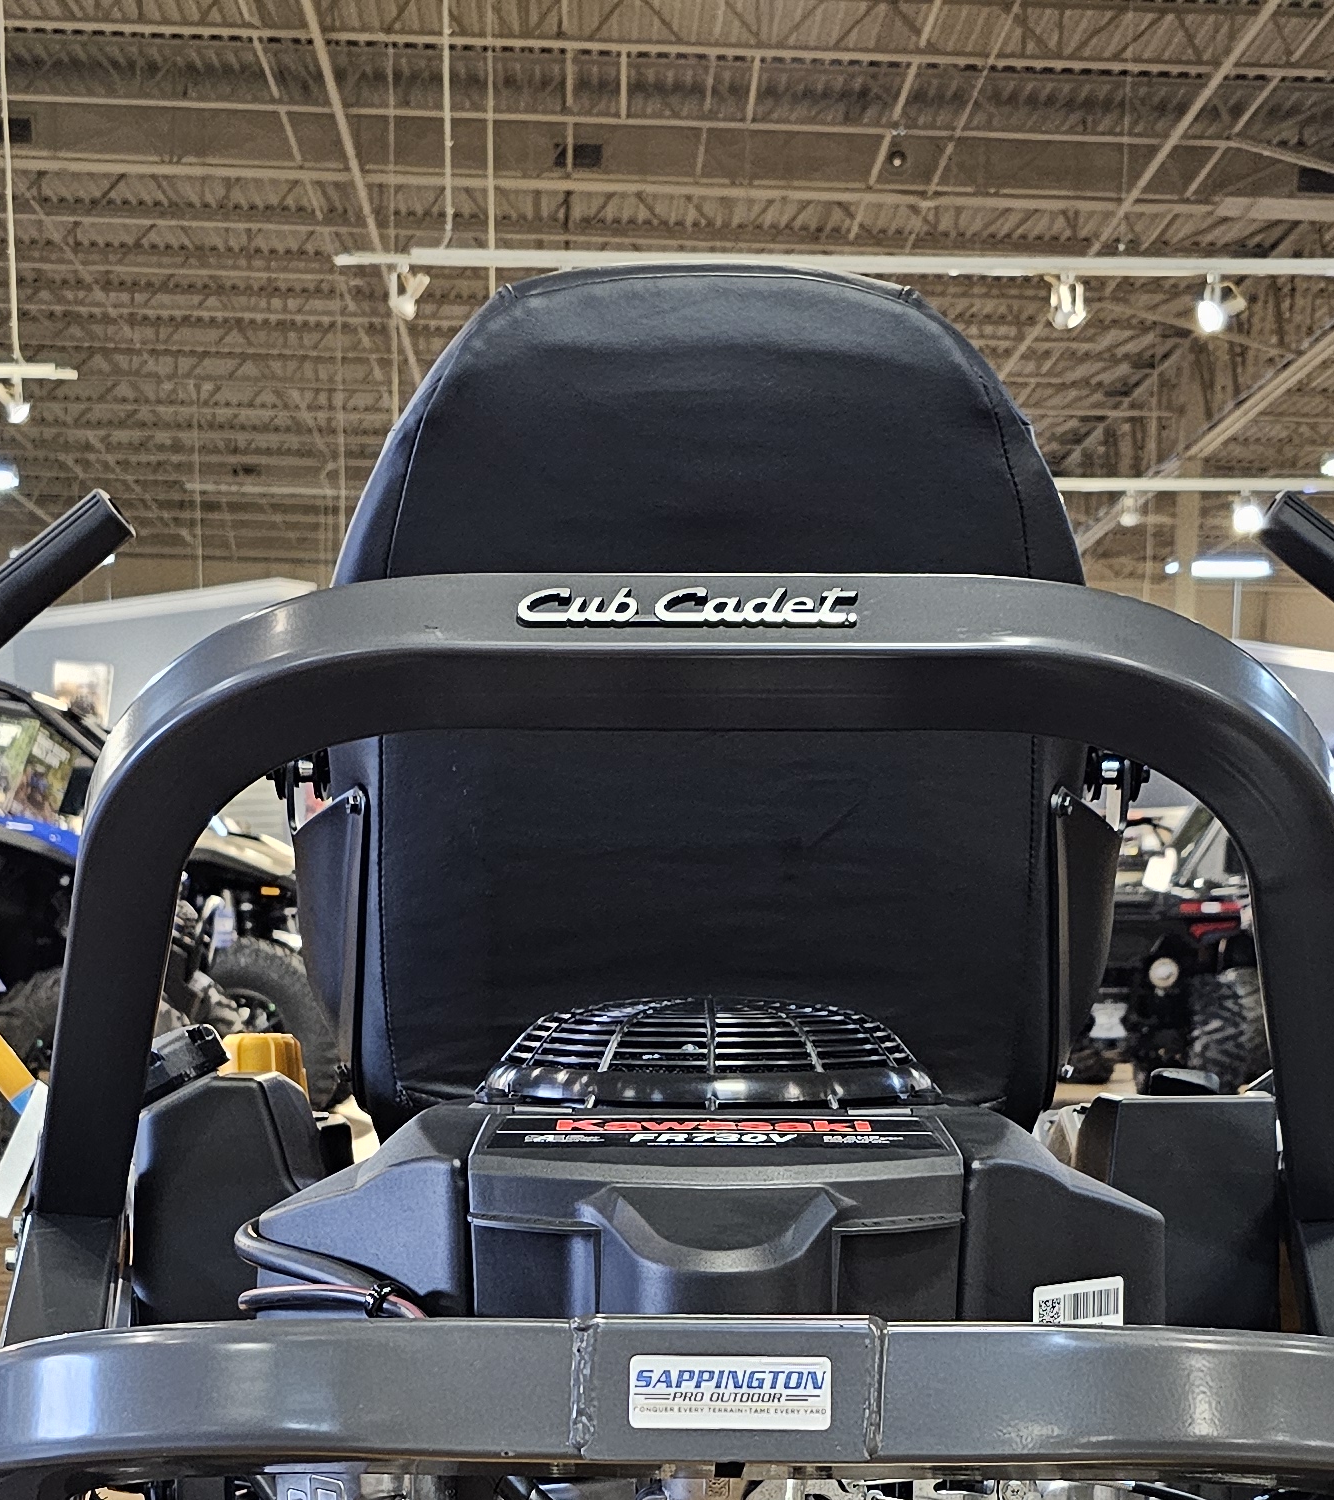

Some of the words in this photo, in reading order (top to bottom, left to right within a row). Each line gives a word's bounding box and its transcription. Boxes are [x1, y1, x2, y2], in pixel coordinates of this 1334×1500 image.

[517, 587, 639, 624] Cub
[556, 1119, 872, 1132] Kawasaki
[629, 1133, 798, 1143] FR730V
[635, 1369, 827, 1390] SAPPINGTON
[672, 1391, 705, 1402] PRO
[709, 1391, 783, 1403] OUTDOOR
